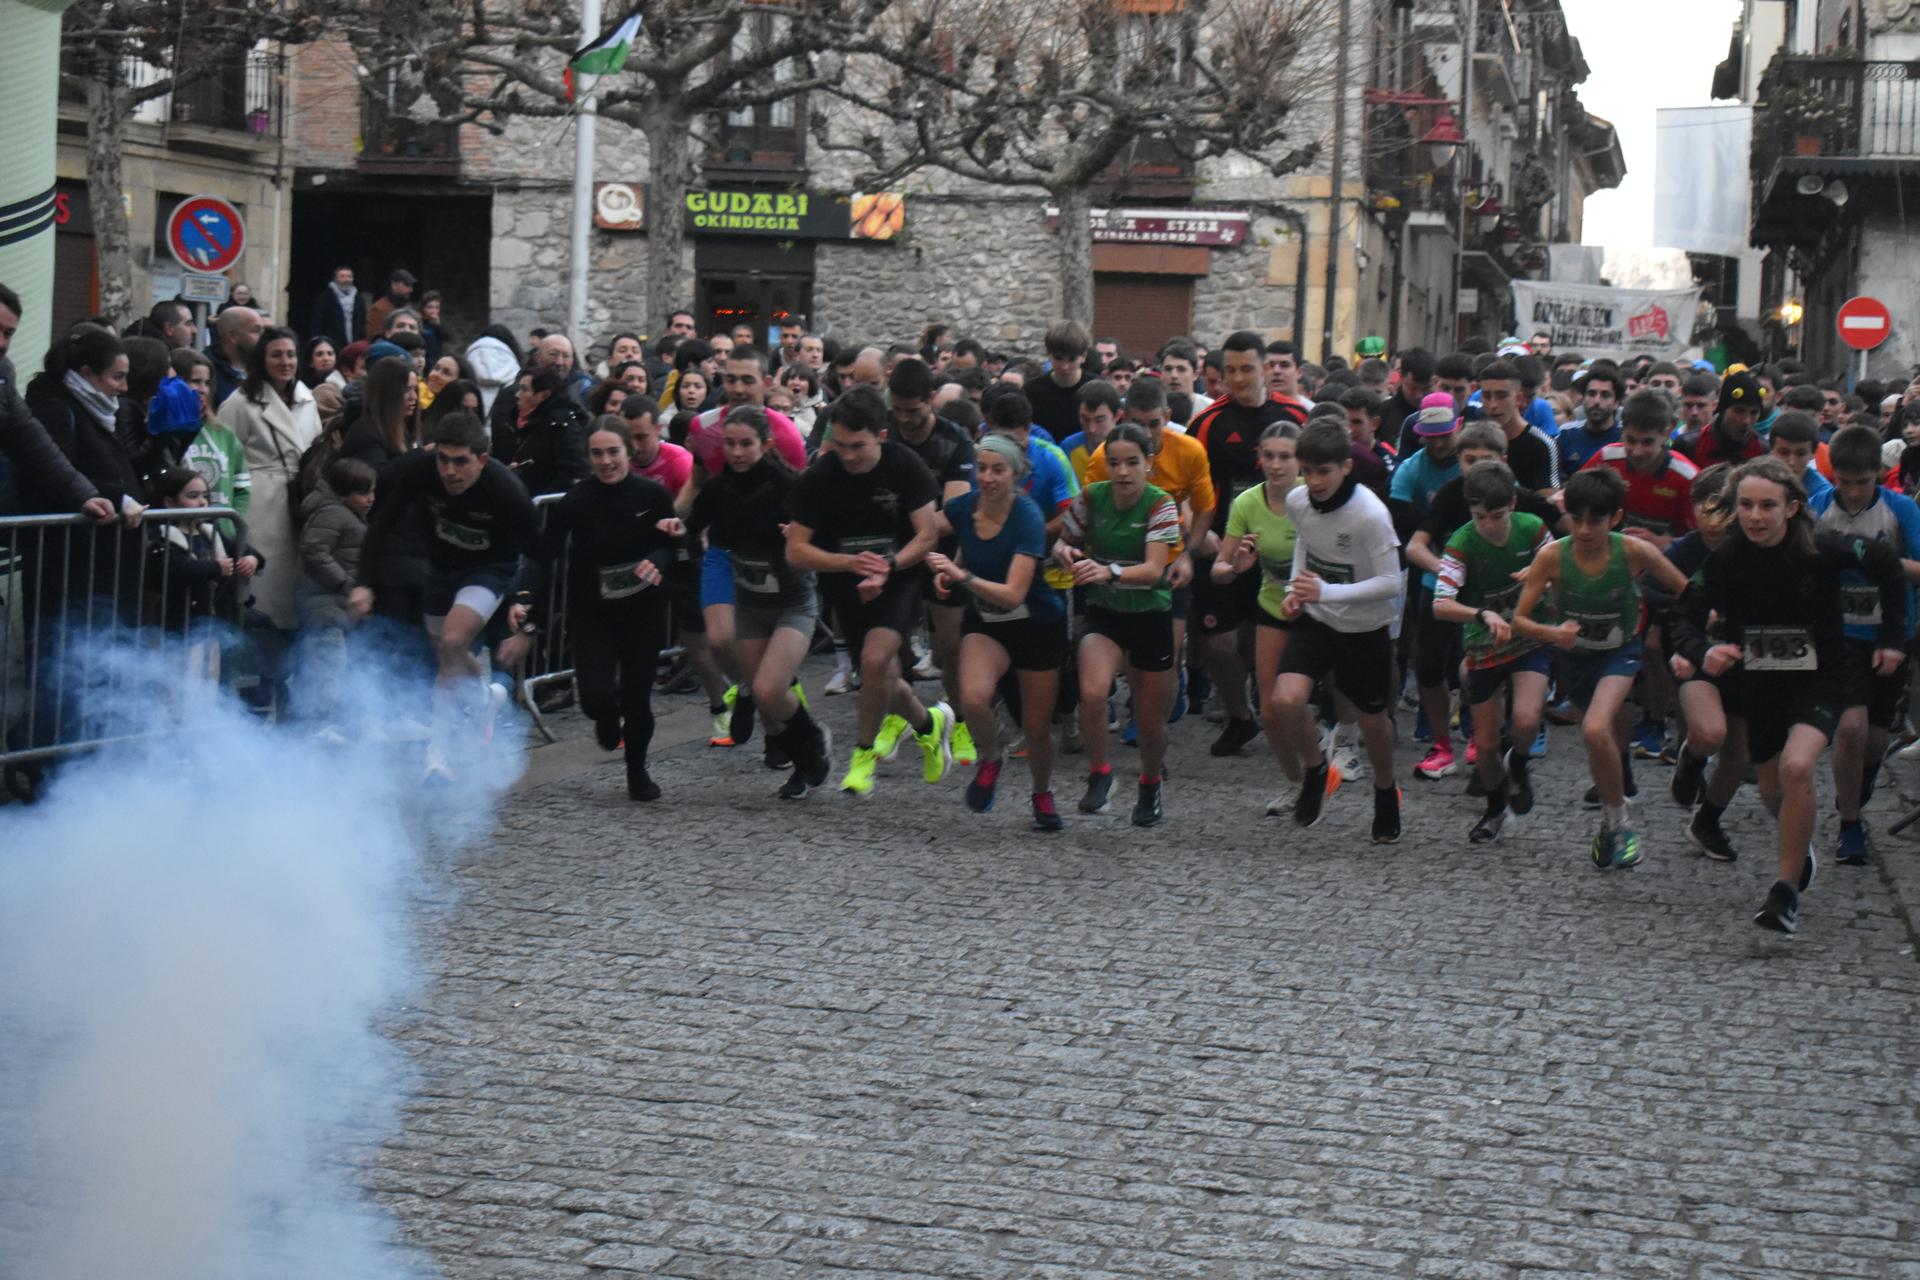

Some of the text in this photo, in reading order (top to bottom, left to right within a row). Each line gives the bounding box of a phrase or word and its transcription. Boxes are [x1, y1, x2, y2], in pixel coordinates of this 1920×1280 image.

[694, 215, 799, 230] OKINDEGIA
[1166, 219, 1219, 233] ETXEA
[1750, 637, 1809, 659] 193
